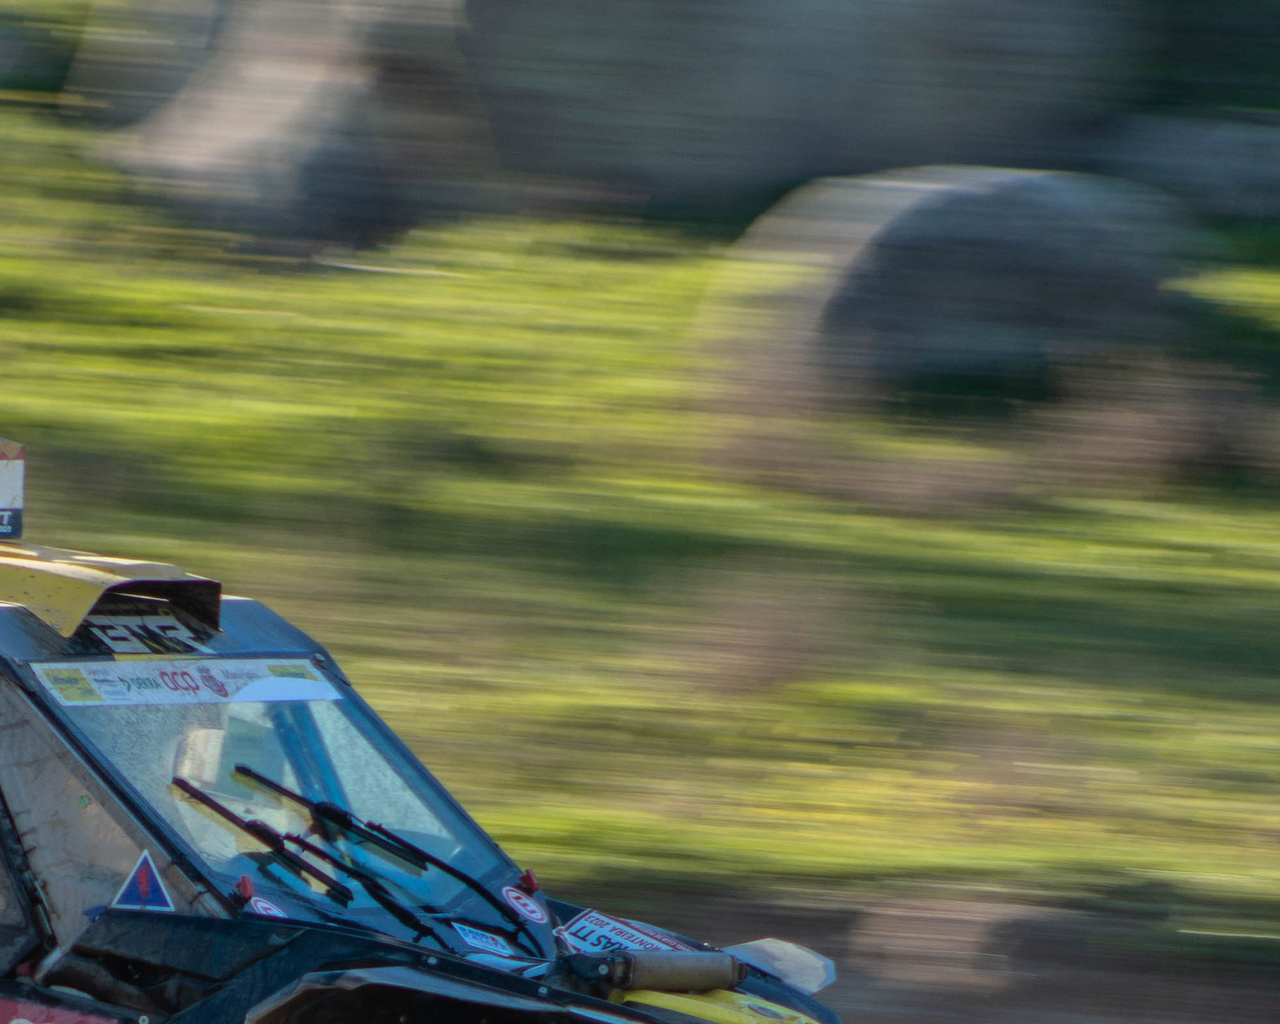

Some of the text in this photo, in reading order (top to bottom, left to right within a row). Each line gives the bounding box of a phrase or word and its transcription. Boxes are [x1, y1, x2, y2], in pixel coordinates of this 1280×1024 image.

[160, 671, 200, 695] acp
[584, 915, 611, 928] 2023
[570, 926, 596, 941] TT
[610, 926, 662, 951] RONTEIRA
